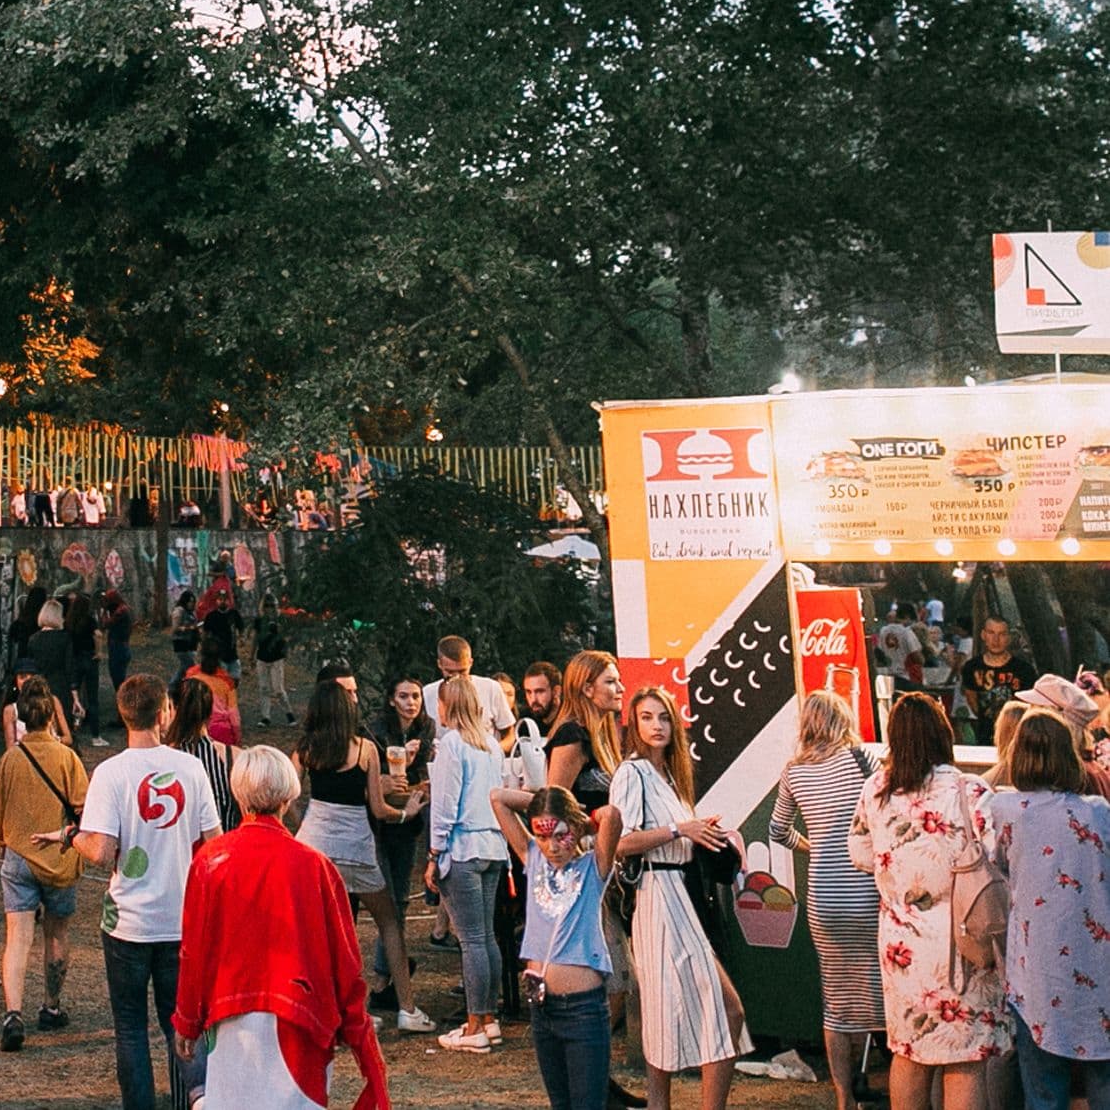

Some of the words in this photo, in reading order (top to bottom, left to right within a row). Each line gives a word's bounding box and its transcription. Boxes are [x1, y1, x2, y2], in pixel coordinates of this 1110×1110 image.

[862, 443, 895, 458] ONE
[896, 442, 938, 456] ГОГИ
[986, 435, 1067, 450] ЧИПСТЕР
[828, 484, 859, 499] 350
[974, 480, 1003, 493] 350
[649, 492, 769, 518] НАХЛЕБНИК
[710, 540, 734, 557] and
